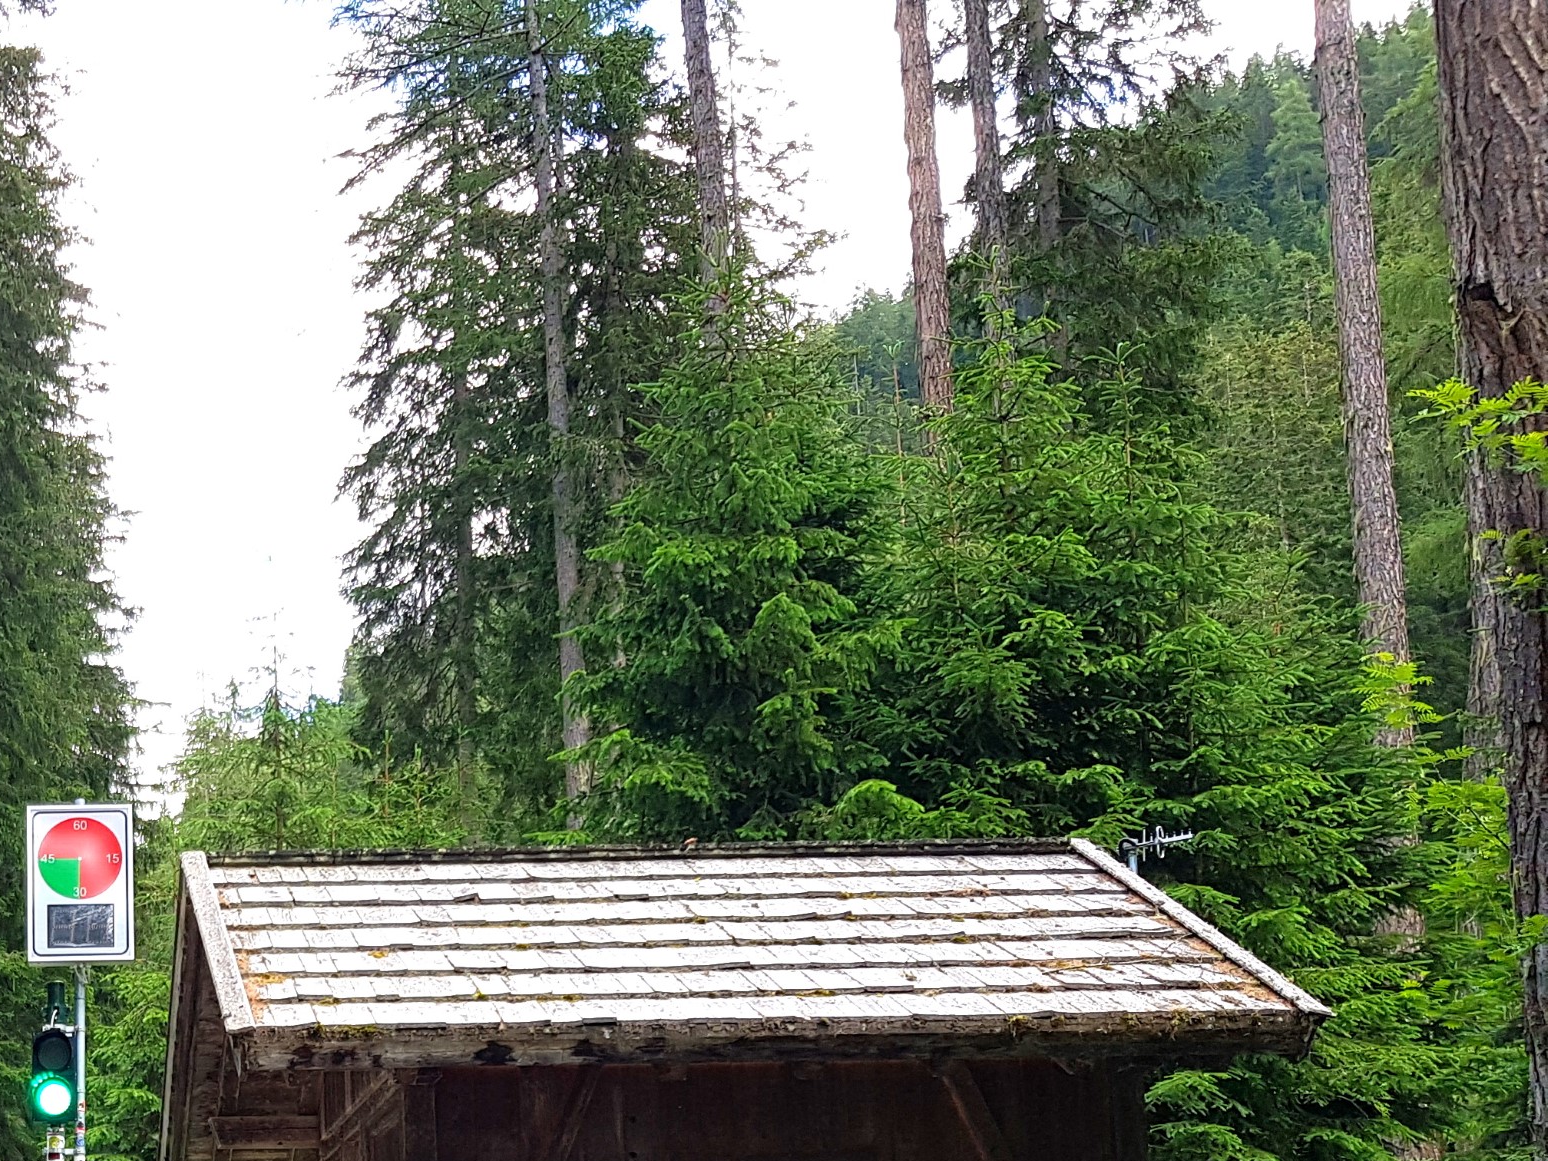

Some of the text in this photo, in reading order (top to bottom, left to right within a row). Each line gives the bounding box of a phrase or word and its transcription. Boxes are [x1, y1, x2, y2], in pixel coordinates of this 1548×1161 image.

[73, 820, 87, 831] 60
[40, 854, 55, 863] 45
[106, 854, 119, 863] 15
[73, 887, 87, 897] 30
